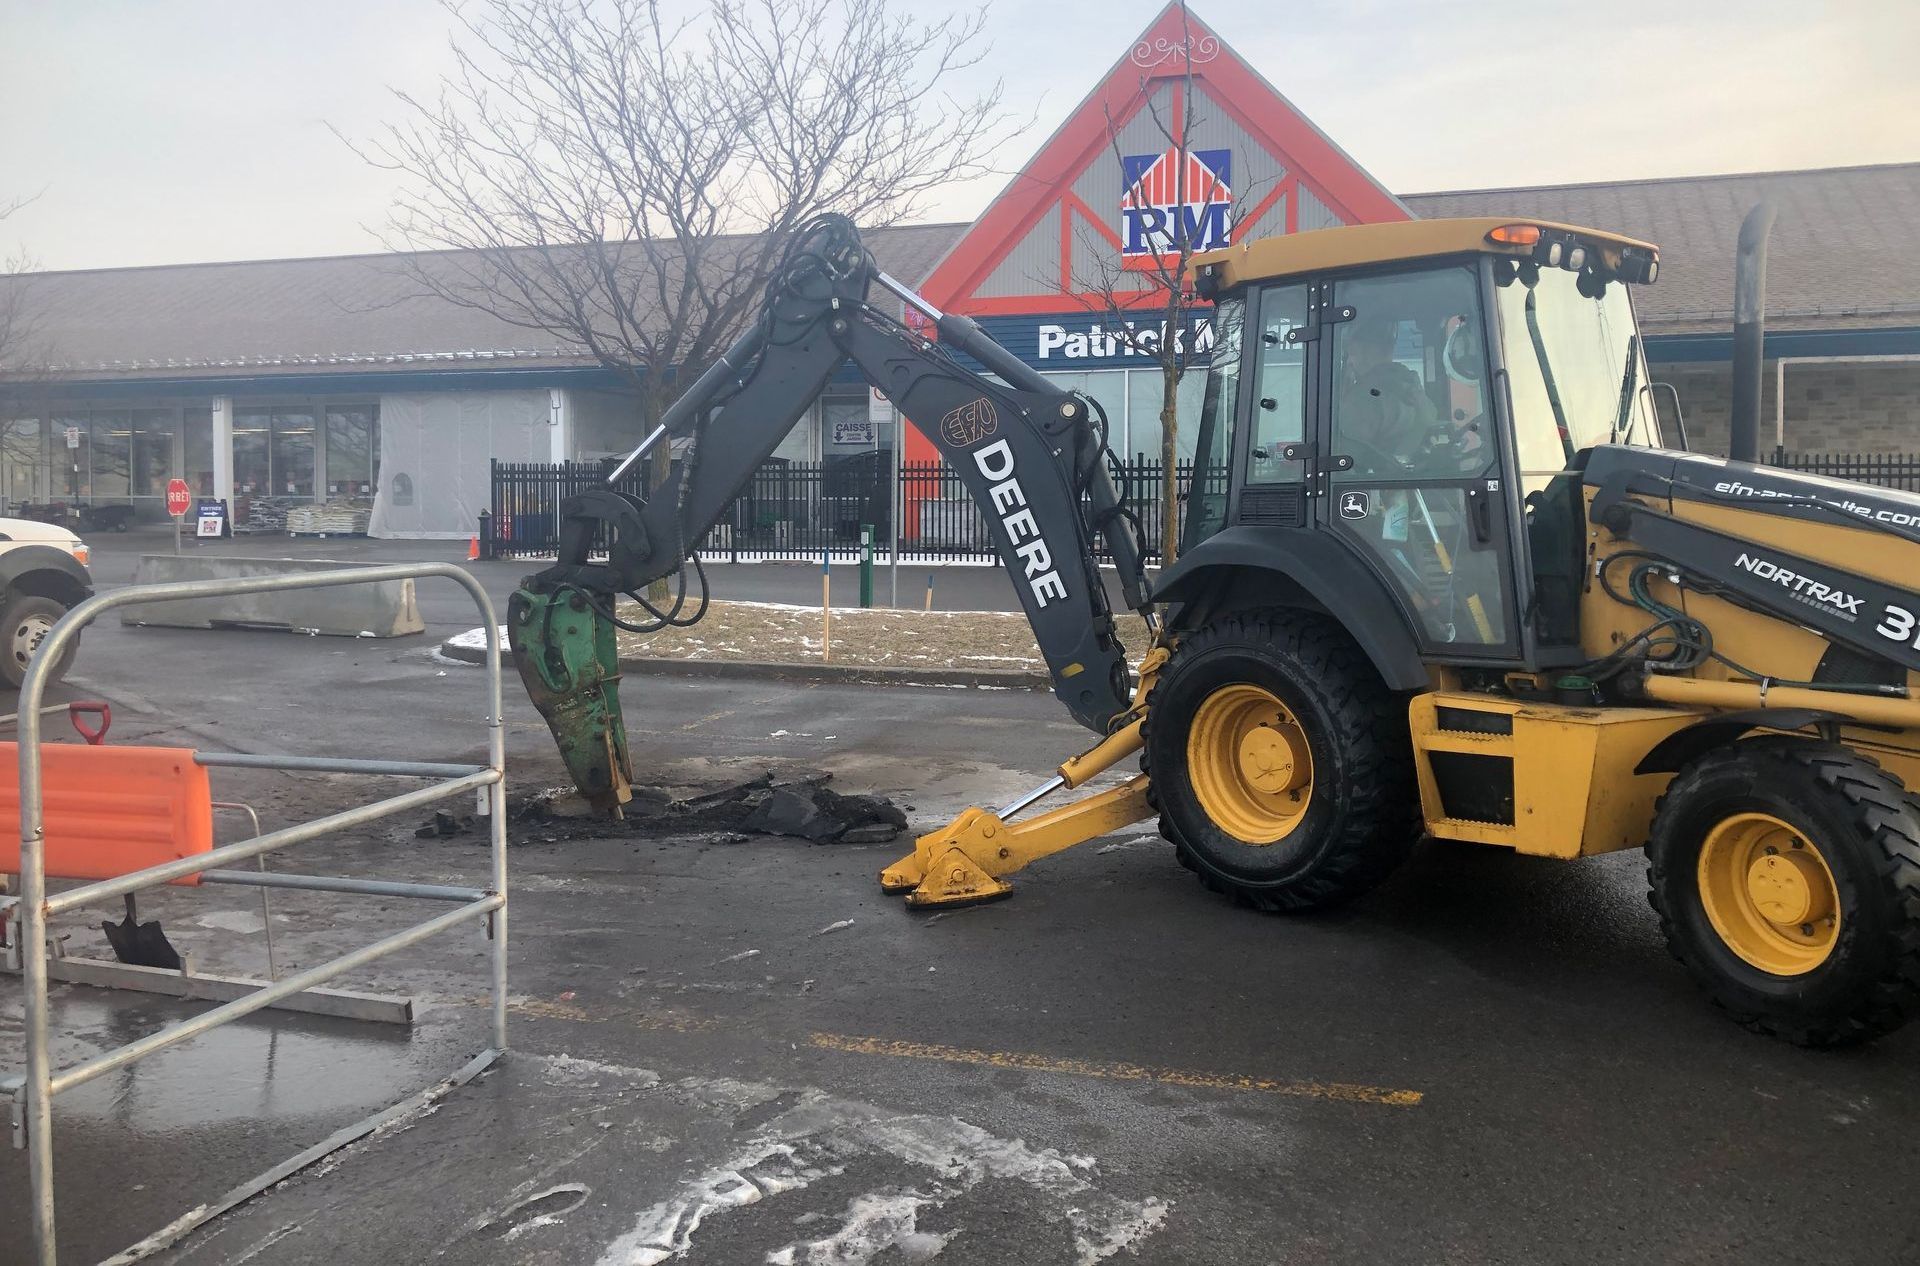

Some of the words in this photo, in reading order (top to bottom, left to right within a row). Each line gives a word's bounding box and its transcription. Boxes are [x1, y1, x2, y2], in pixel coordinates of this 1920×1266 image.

[1038, 321, 1186, 358] Patrick
[836, 423, 871, 432] CAISSE
[169, 490, 189, 502] RRÊT
[973, 438, 1068, 608] DEERE
[1734, 553, 1866, 615] NORTRAX
